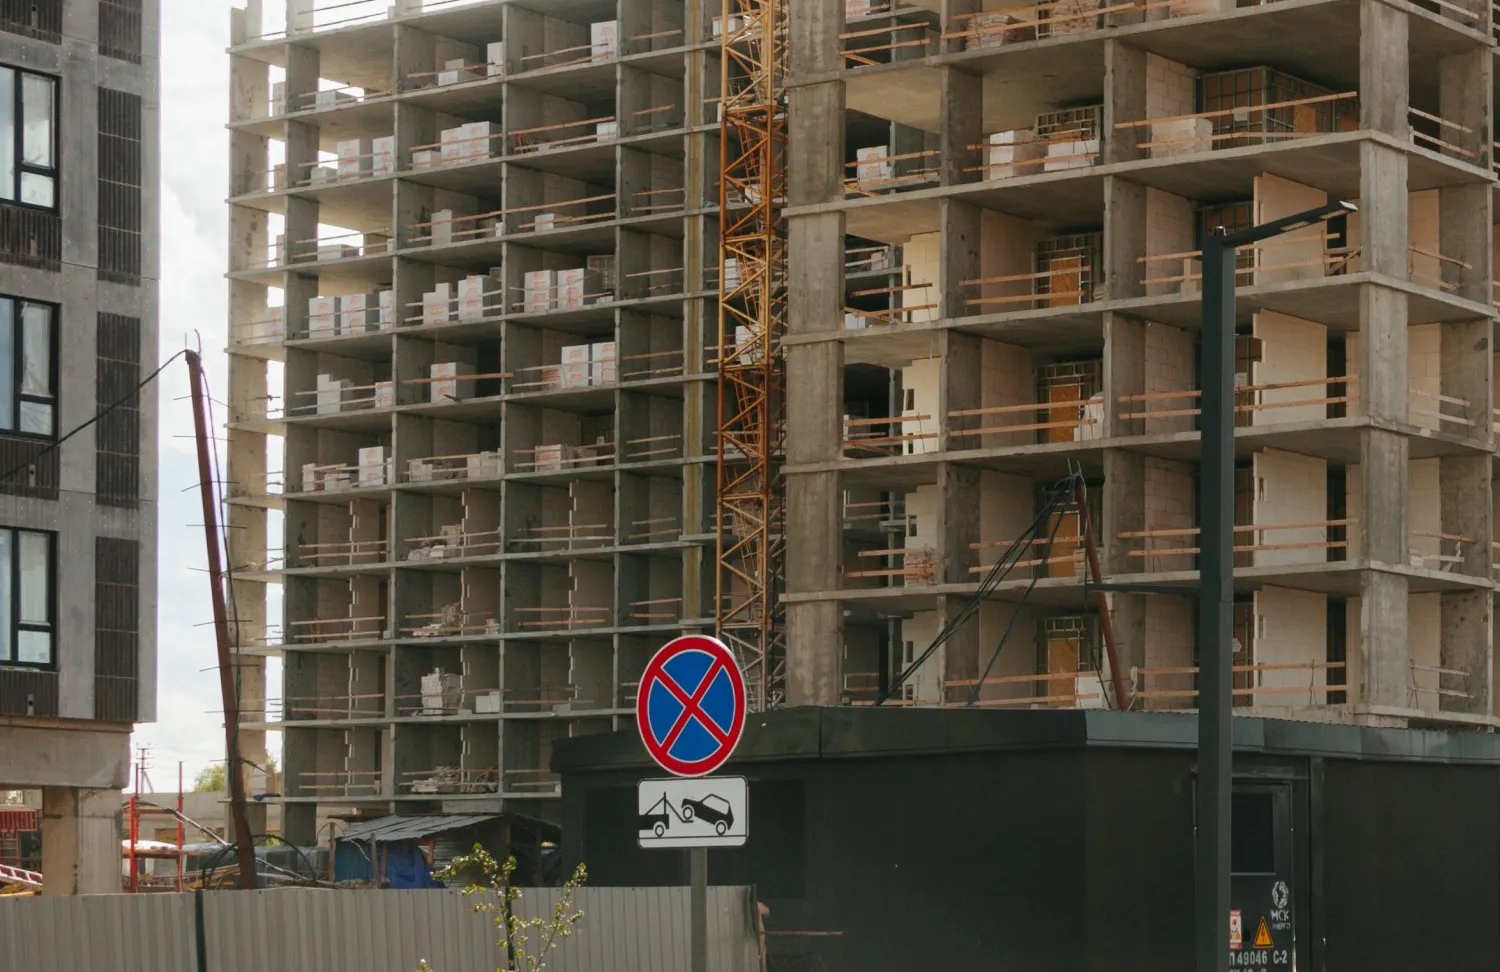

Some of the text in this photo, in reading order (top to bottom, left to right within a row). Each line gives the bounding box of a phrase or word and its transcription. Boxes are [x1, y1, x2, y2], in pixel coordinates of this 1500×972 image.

[1270, 909, 1289, 921] МСК
[1237, 950, 1268, 966] 49046
[1273, 949, 1288, 964] С-2
